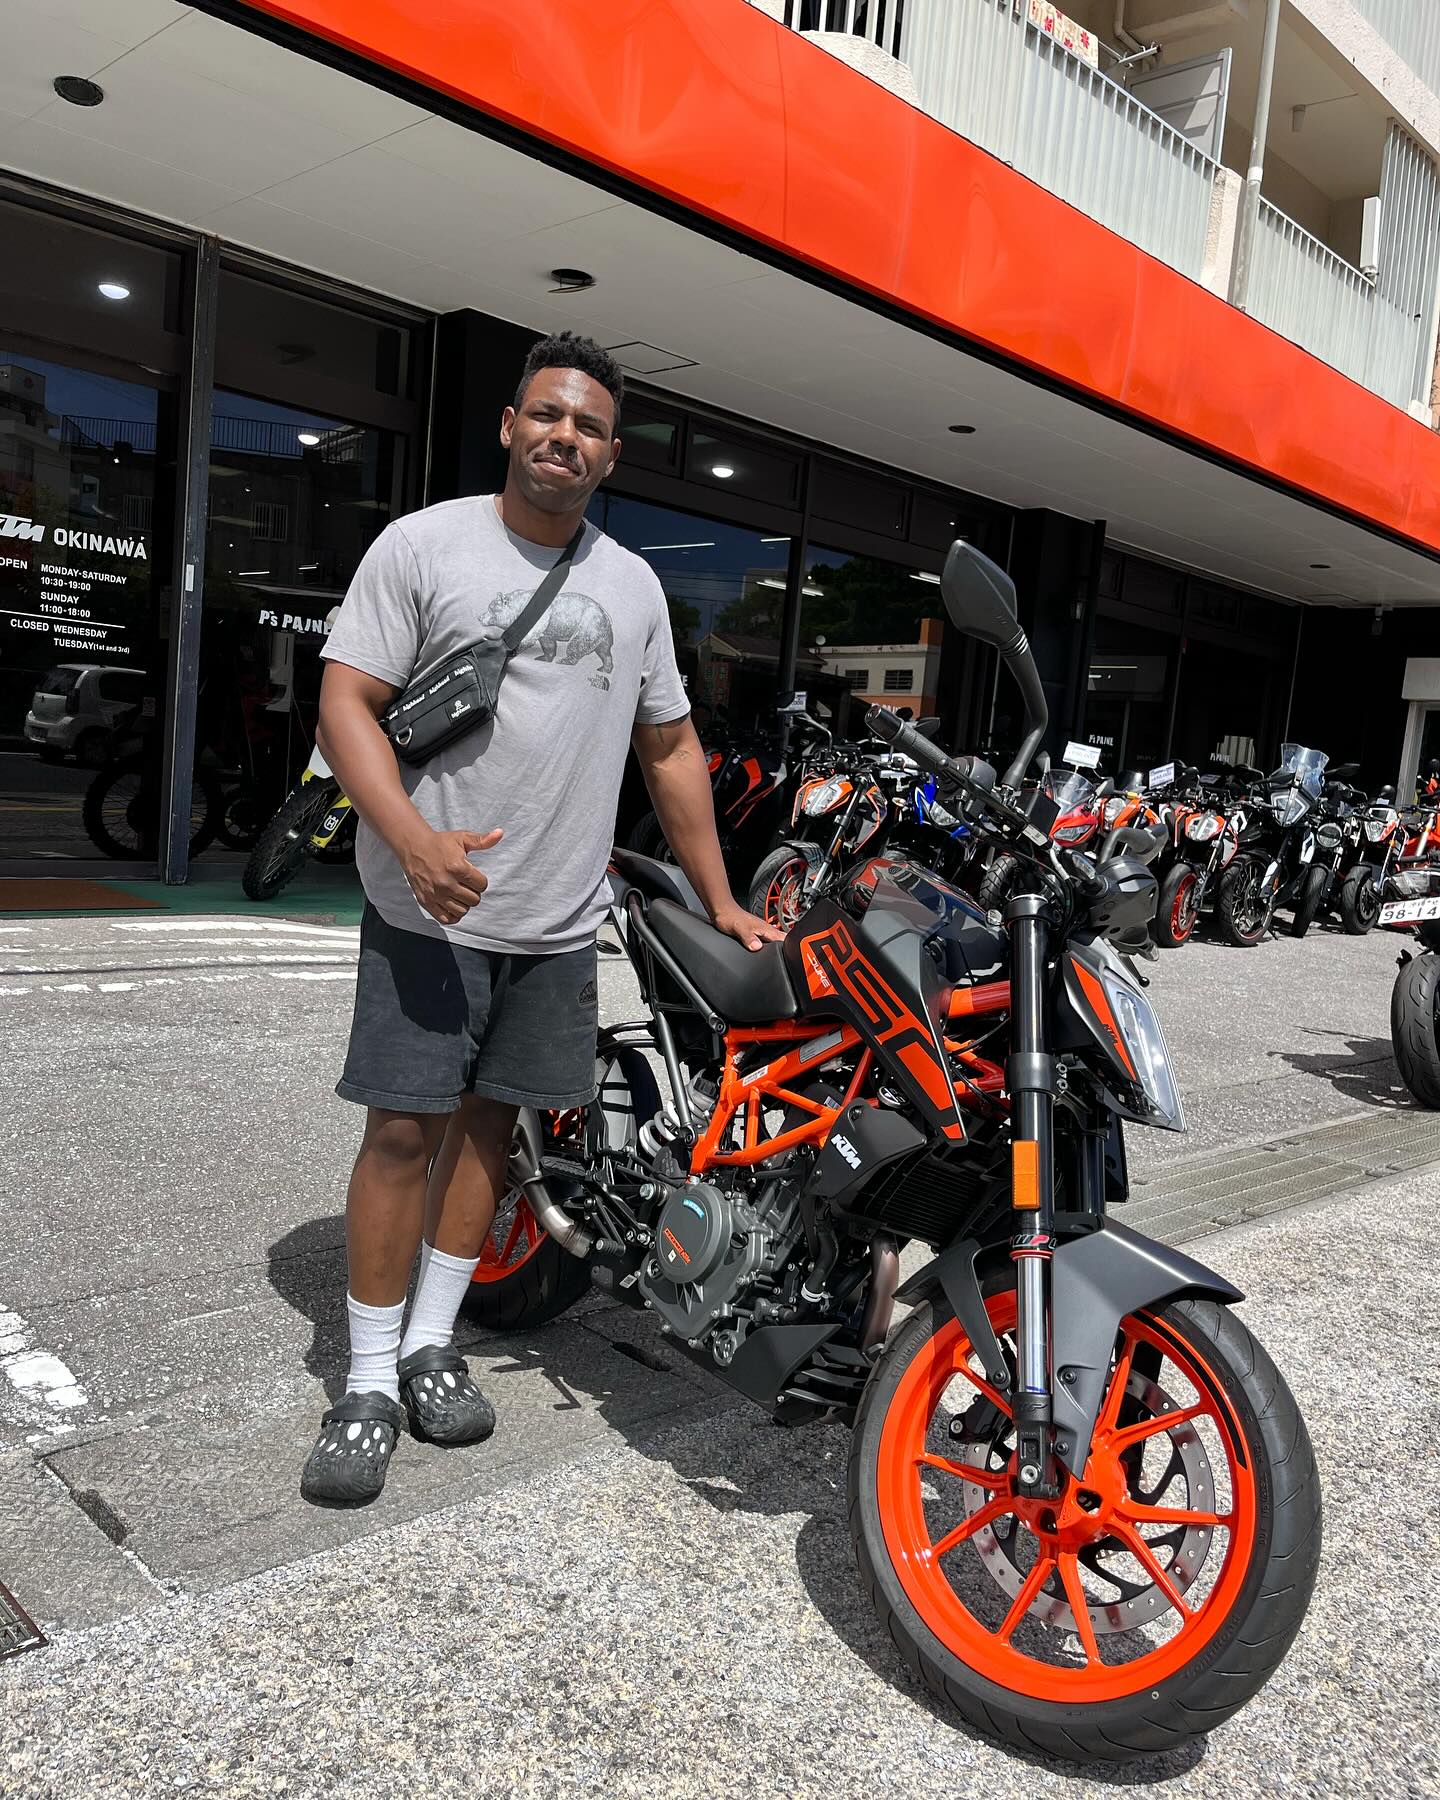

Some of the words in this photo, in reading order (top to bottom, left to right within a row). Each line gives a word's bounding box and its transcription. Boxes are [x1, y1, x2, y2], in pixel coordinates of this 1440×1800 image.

[53, 527, 147, 560] OKINAWA
[40, 576, 91, 591] 10:30-19:00
[41, 564, 127, 584] MONDAY-SATURDAY
[40, 591, 79, 604] SUNDAY
[40, 603, 91, 618] 11:00-18:00
[10, 618, 49, 632] CLOSED
[53, 624, 107, 639] WEDNESDAY
[105, 645, 117, 653] and
[806, 952, 831, 989] DUKE
[830, 1132, 862, 1170] KTM
